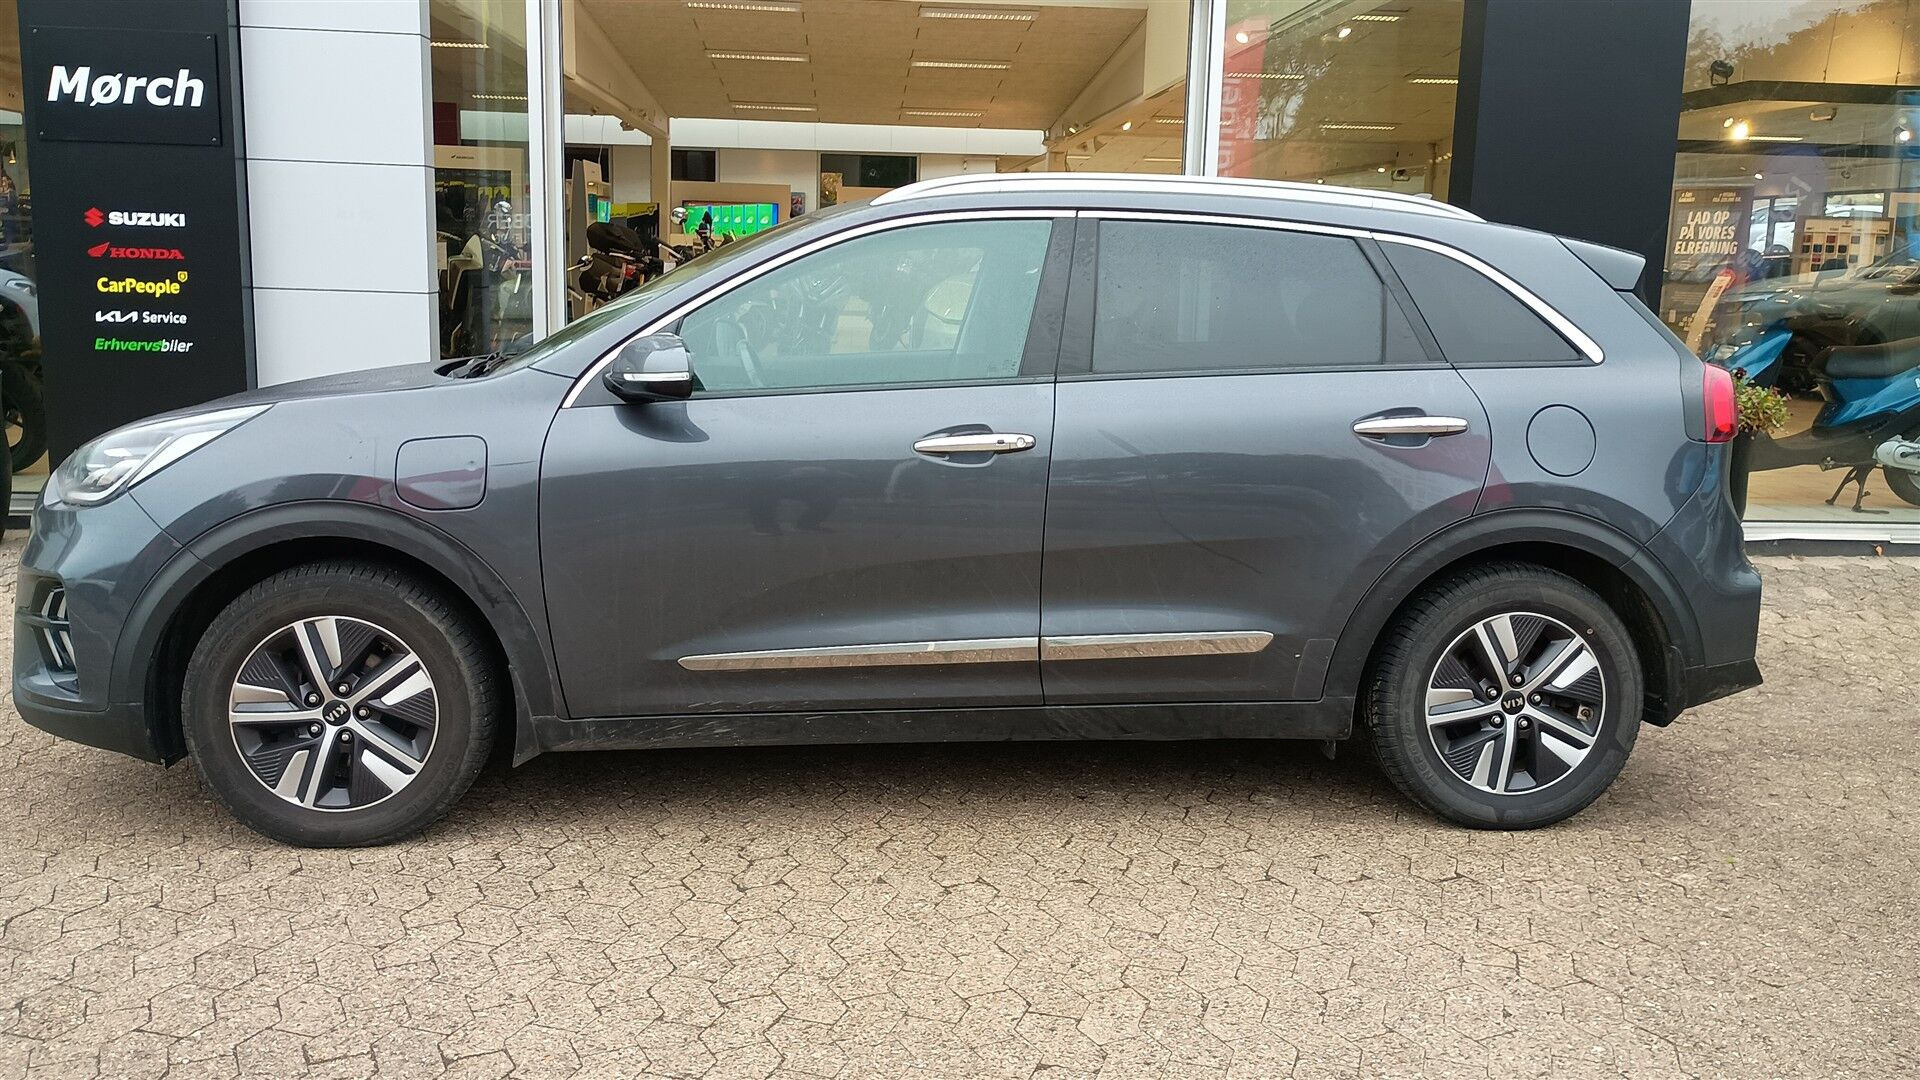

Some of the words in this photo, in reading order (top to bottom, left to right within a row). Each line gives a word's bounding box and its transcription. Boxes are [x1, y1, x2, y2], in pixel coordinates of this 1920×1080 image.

[48, 65, 205, 107] Mørch
[108, 211, 186, 227] SUZUKI
[1687, 211, 1711, 225] LAD
[1713, 211, 1730, 225] OP
[1679, 223, 1695, 239] PÅ
[1698, 225, 1736, 240] VORES
[109, 247, 185, 260] HONDA
[1674, 241, 1739, 255] ELREGNING
[97, 277, 180, 297] CarPeople
[142, 311, 187, 324] Service
[95, 338, 194, 352] Erhvervsbiler
[1503, 697, 1524, 709] KIA
[325, 704, 347, 722] KIA
